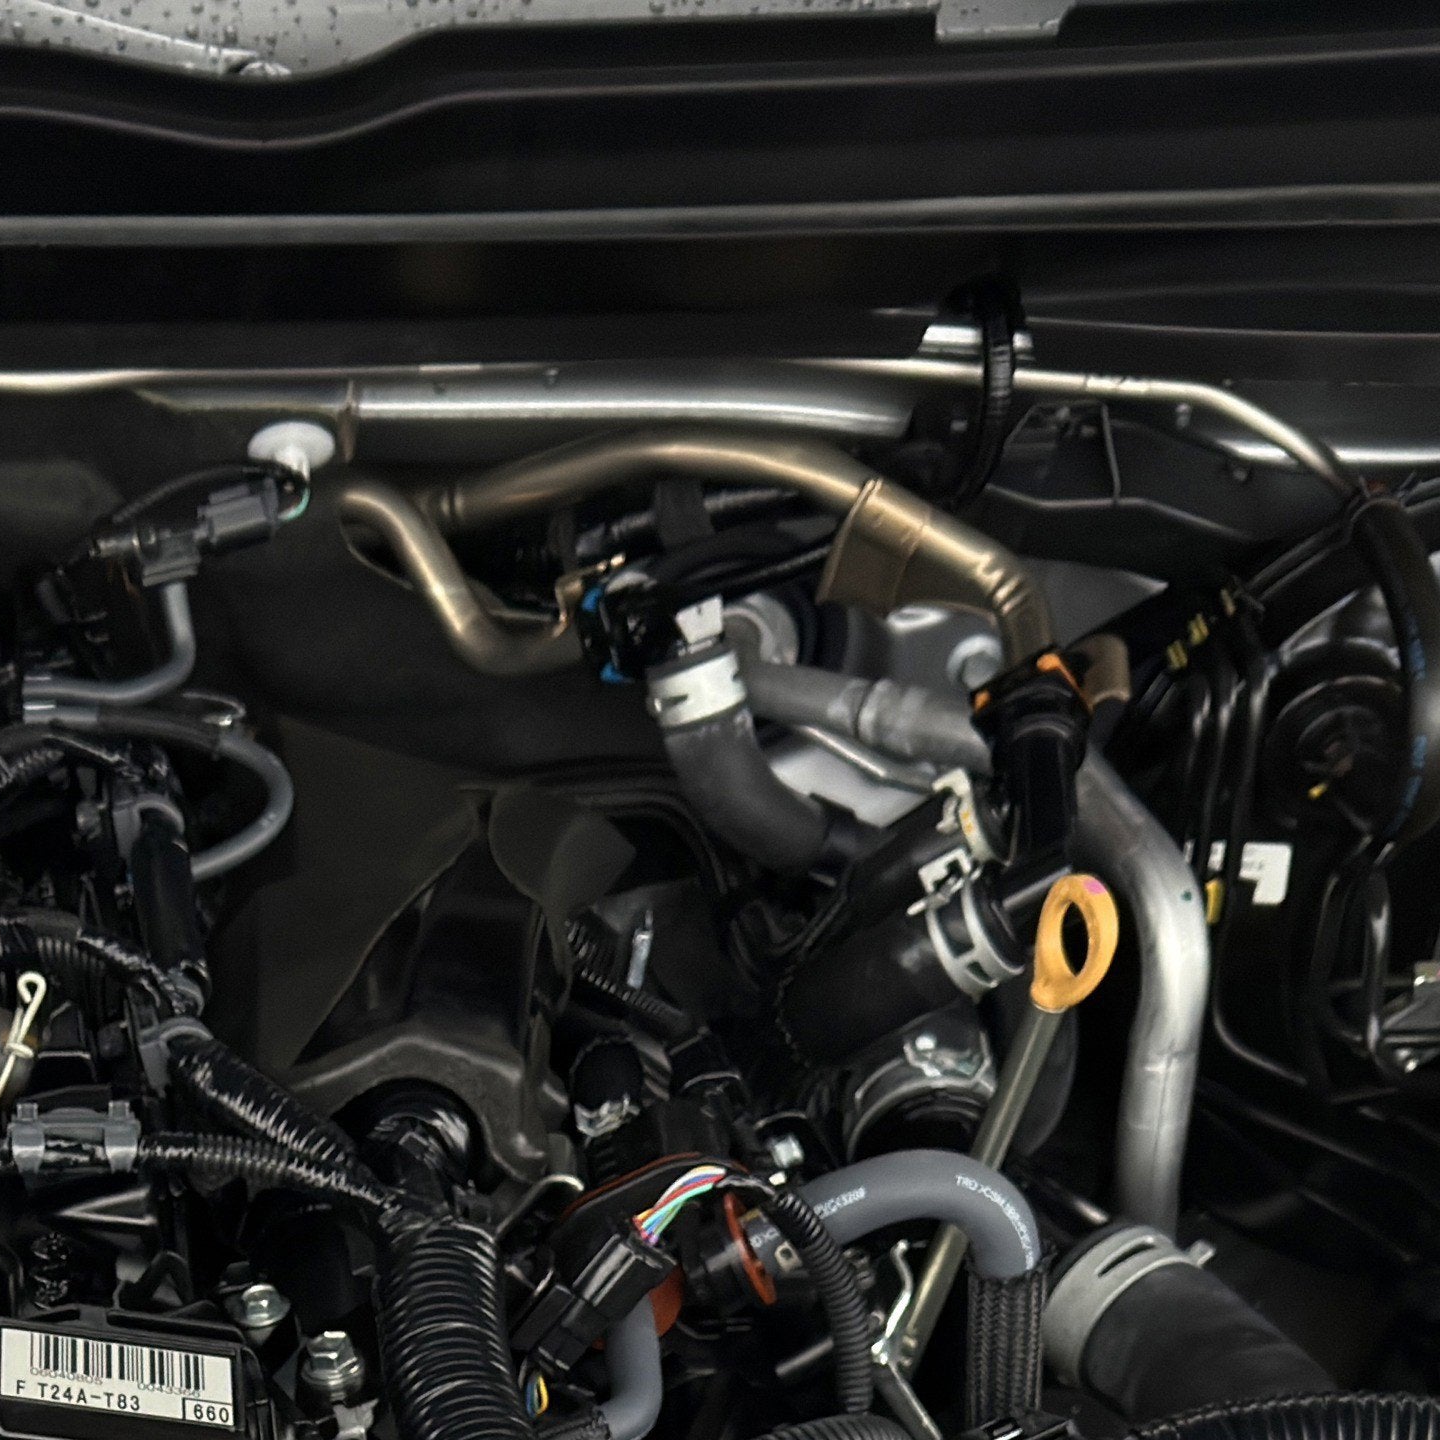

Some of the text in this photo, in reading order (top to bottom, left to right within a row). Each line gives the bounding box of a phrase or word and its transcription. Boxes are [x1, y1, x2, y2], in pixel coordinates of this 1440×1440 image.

[16, 1379, 141, 1411] F T24A-T83
[193, 1404, 230, 1424] 660
